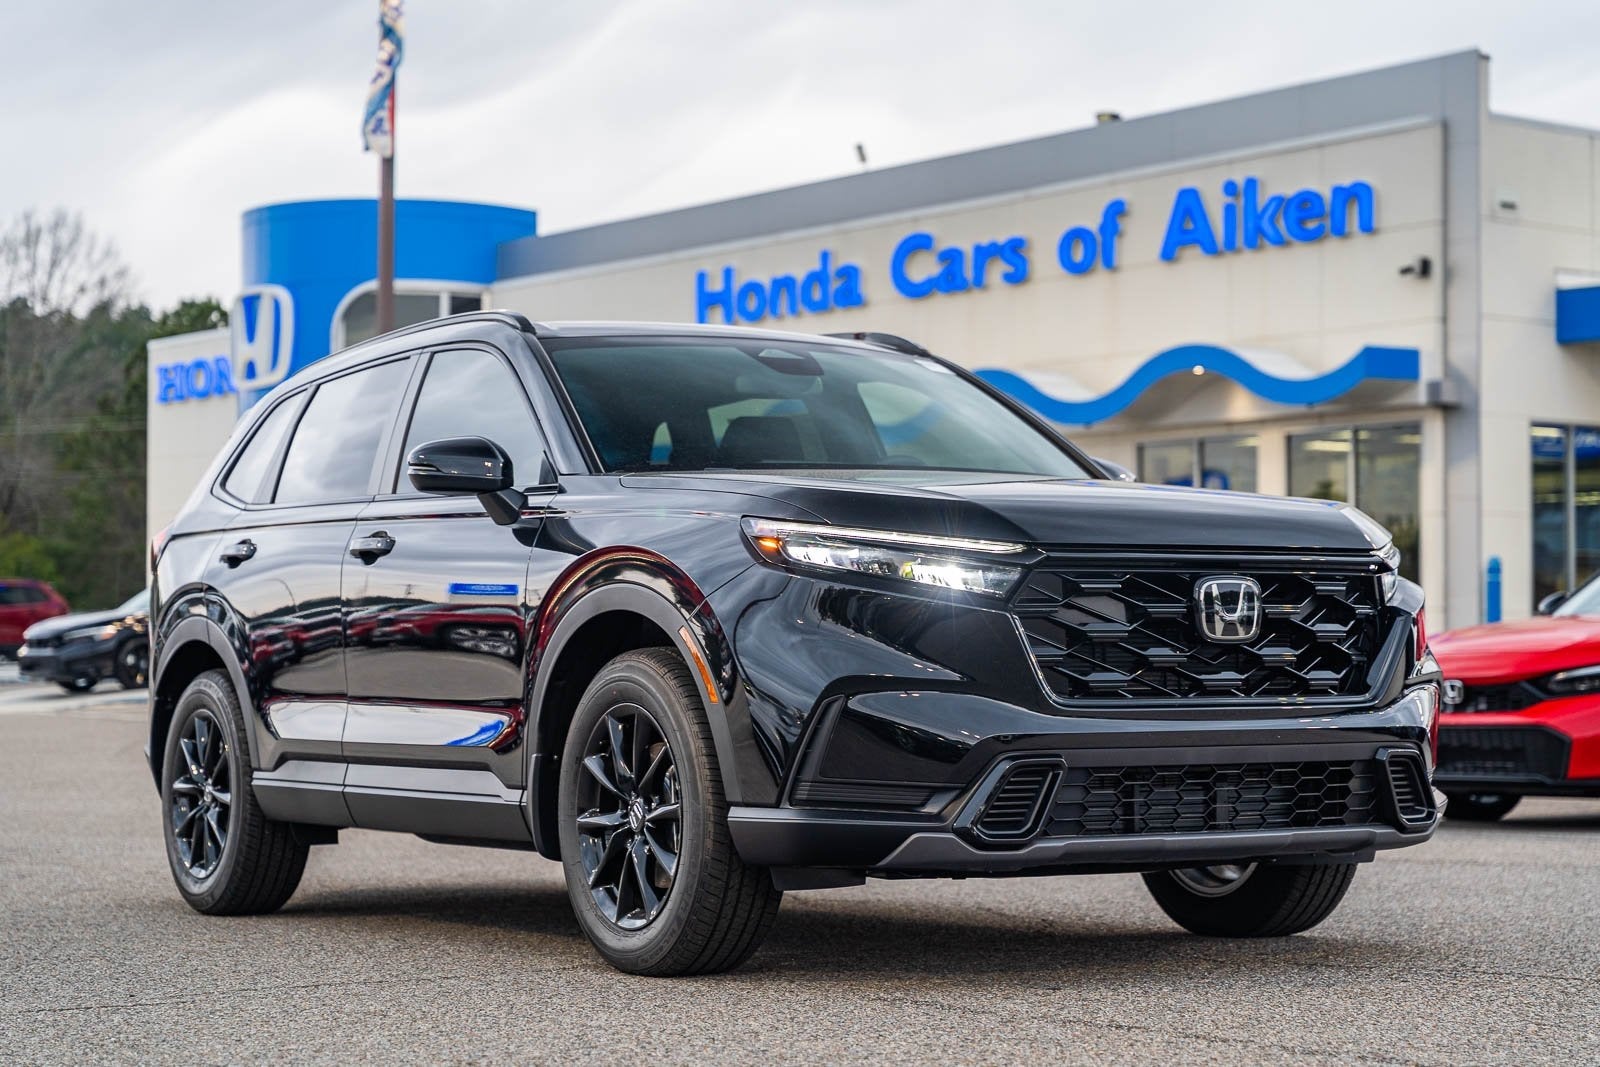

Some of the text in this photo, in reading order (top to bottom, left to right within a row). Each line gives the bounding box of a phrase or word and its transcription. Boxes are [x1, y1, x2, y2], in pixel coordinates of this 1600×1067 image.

[695, 177, 1375, 324] Honda Cars of Aiken
